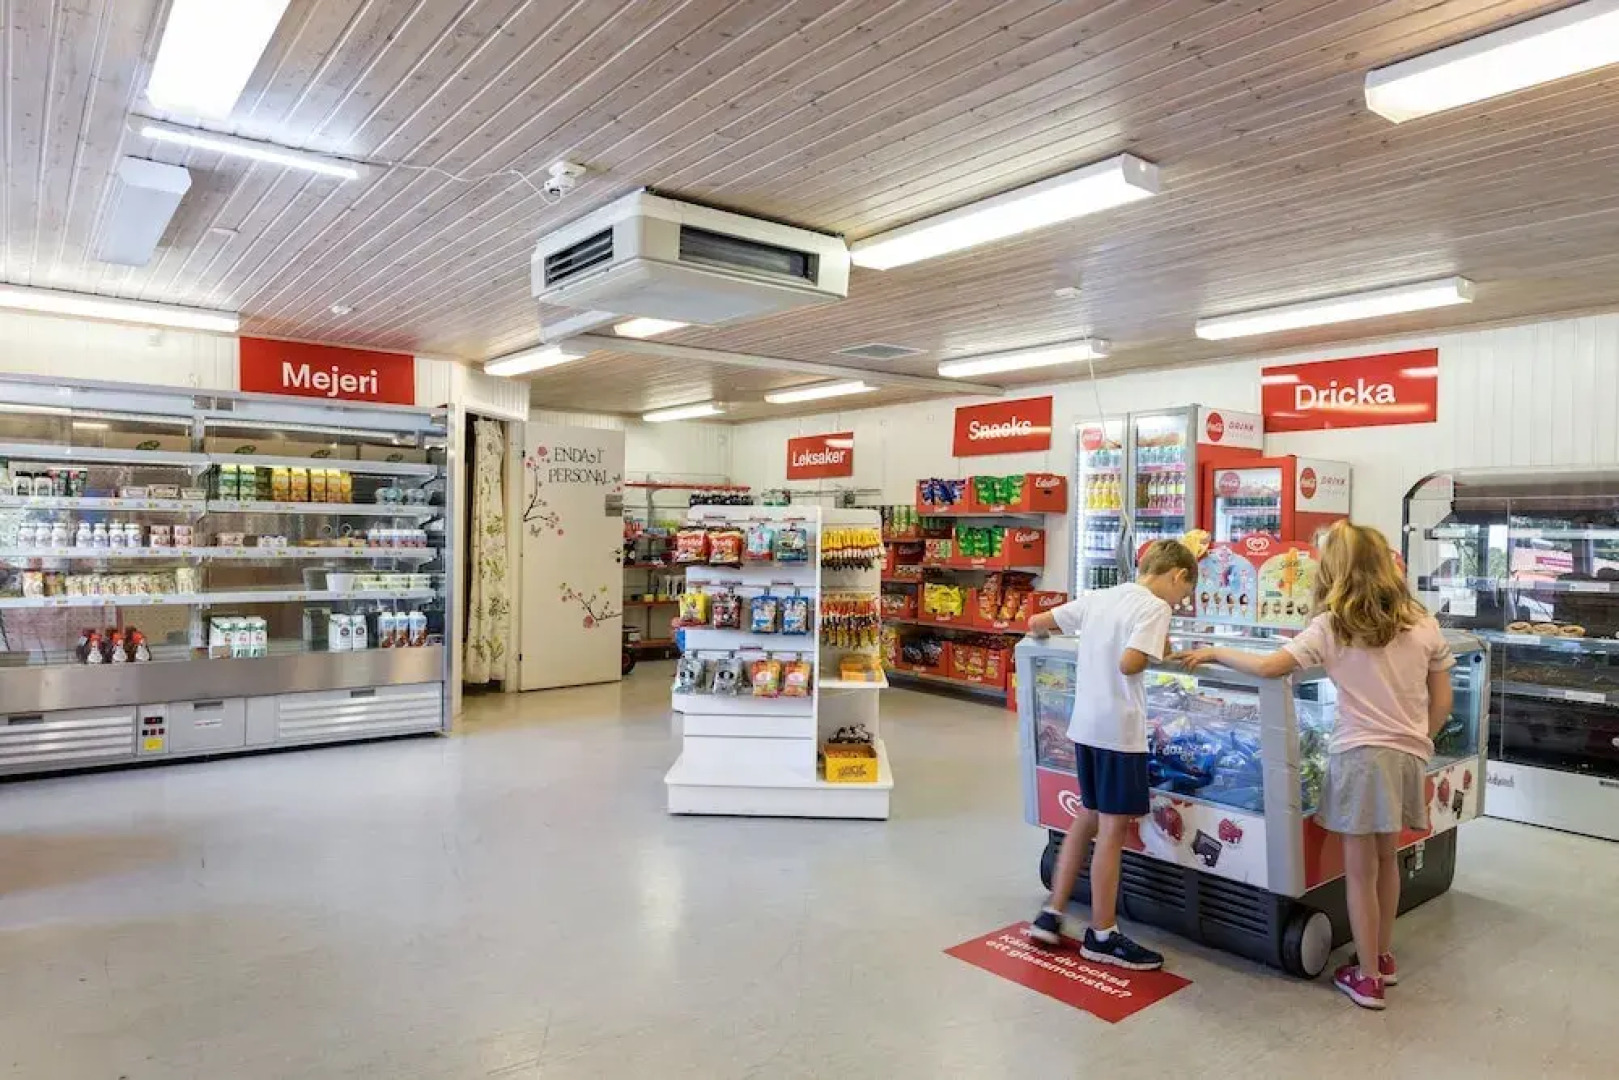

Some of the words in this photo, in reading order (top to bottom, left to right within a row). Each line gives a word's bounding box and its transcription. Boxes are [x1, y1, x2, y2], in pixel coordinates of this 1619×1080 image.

[282, 361, 378, 397] Mejeri
[1294, 378, 1396, 411] Dricka
[968, 415, 1032, 440] Snacks
[554, 446, 605, 464] ENDAST
[792, 448, 845, 467] Leksaker
[548, 467, 609, 486] PERSONAL
[1053, 956, 1078, 968] du
[1006, 949, 1133, 998] glassmonster?
